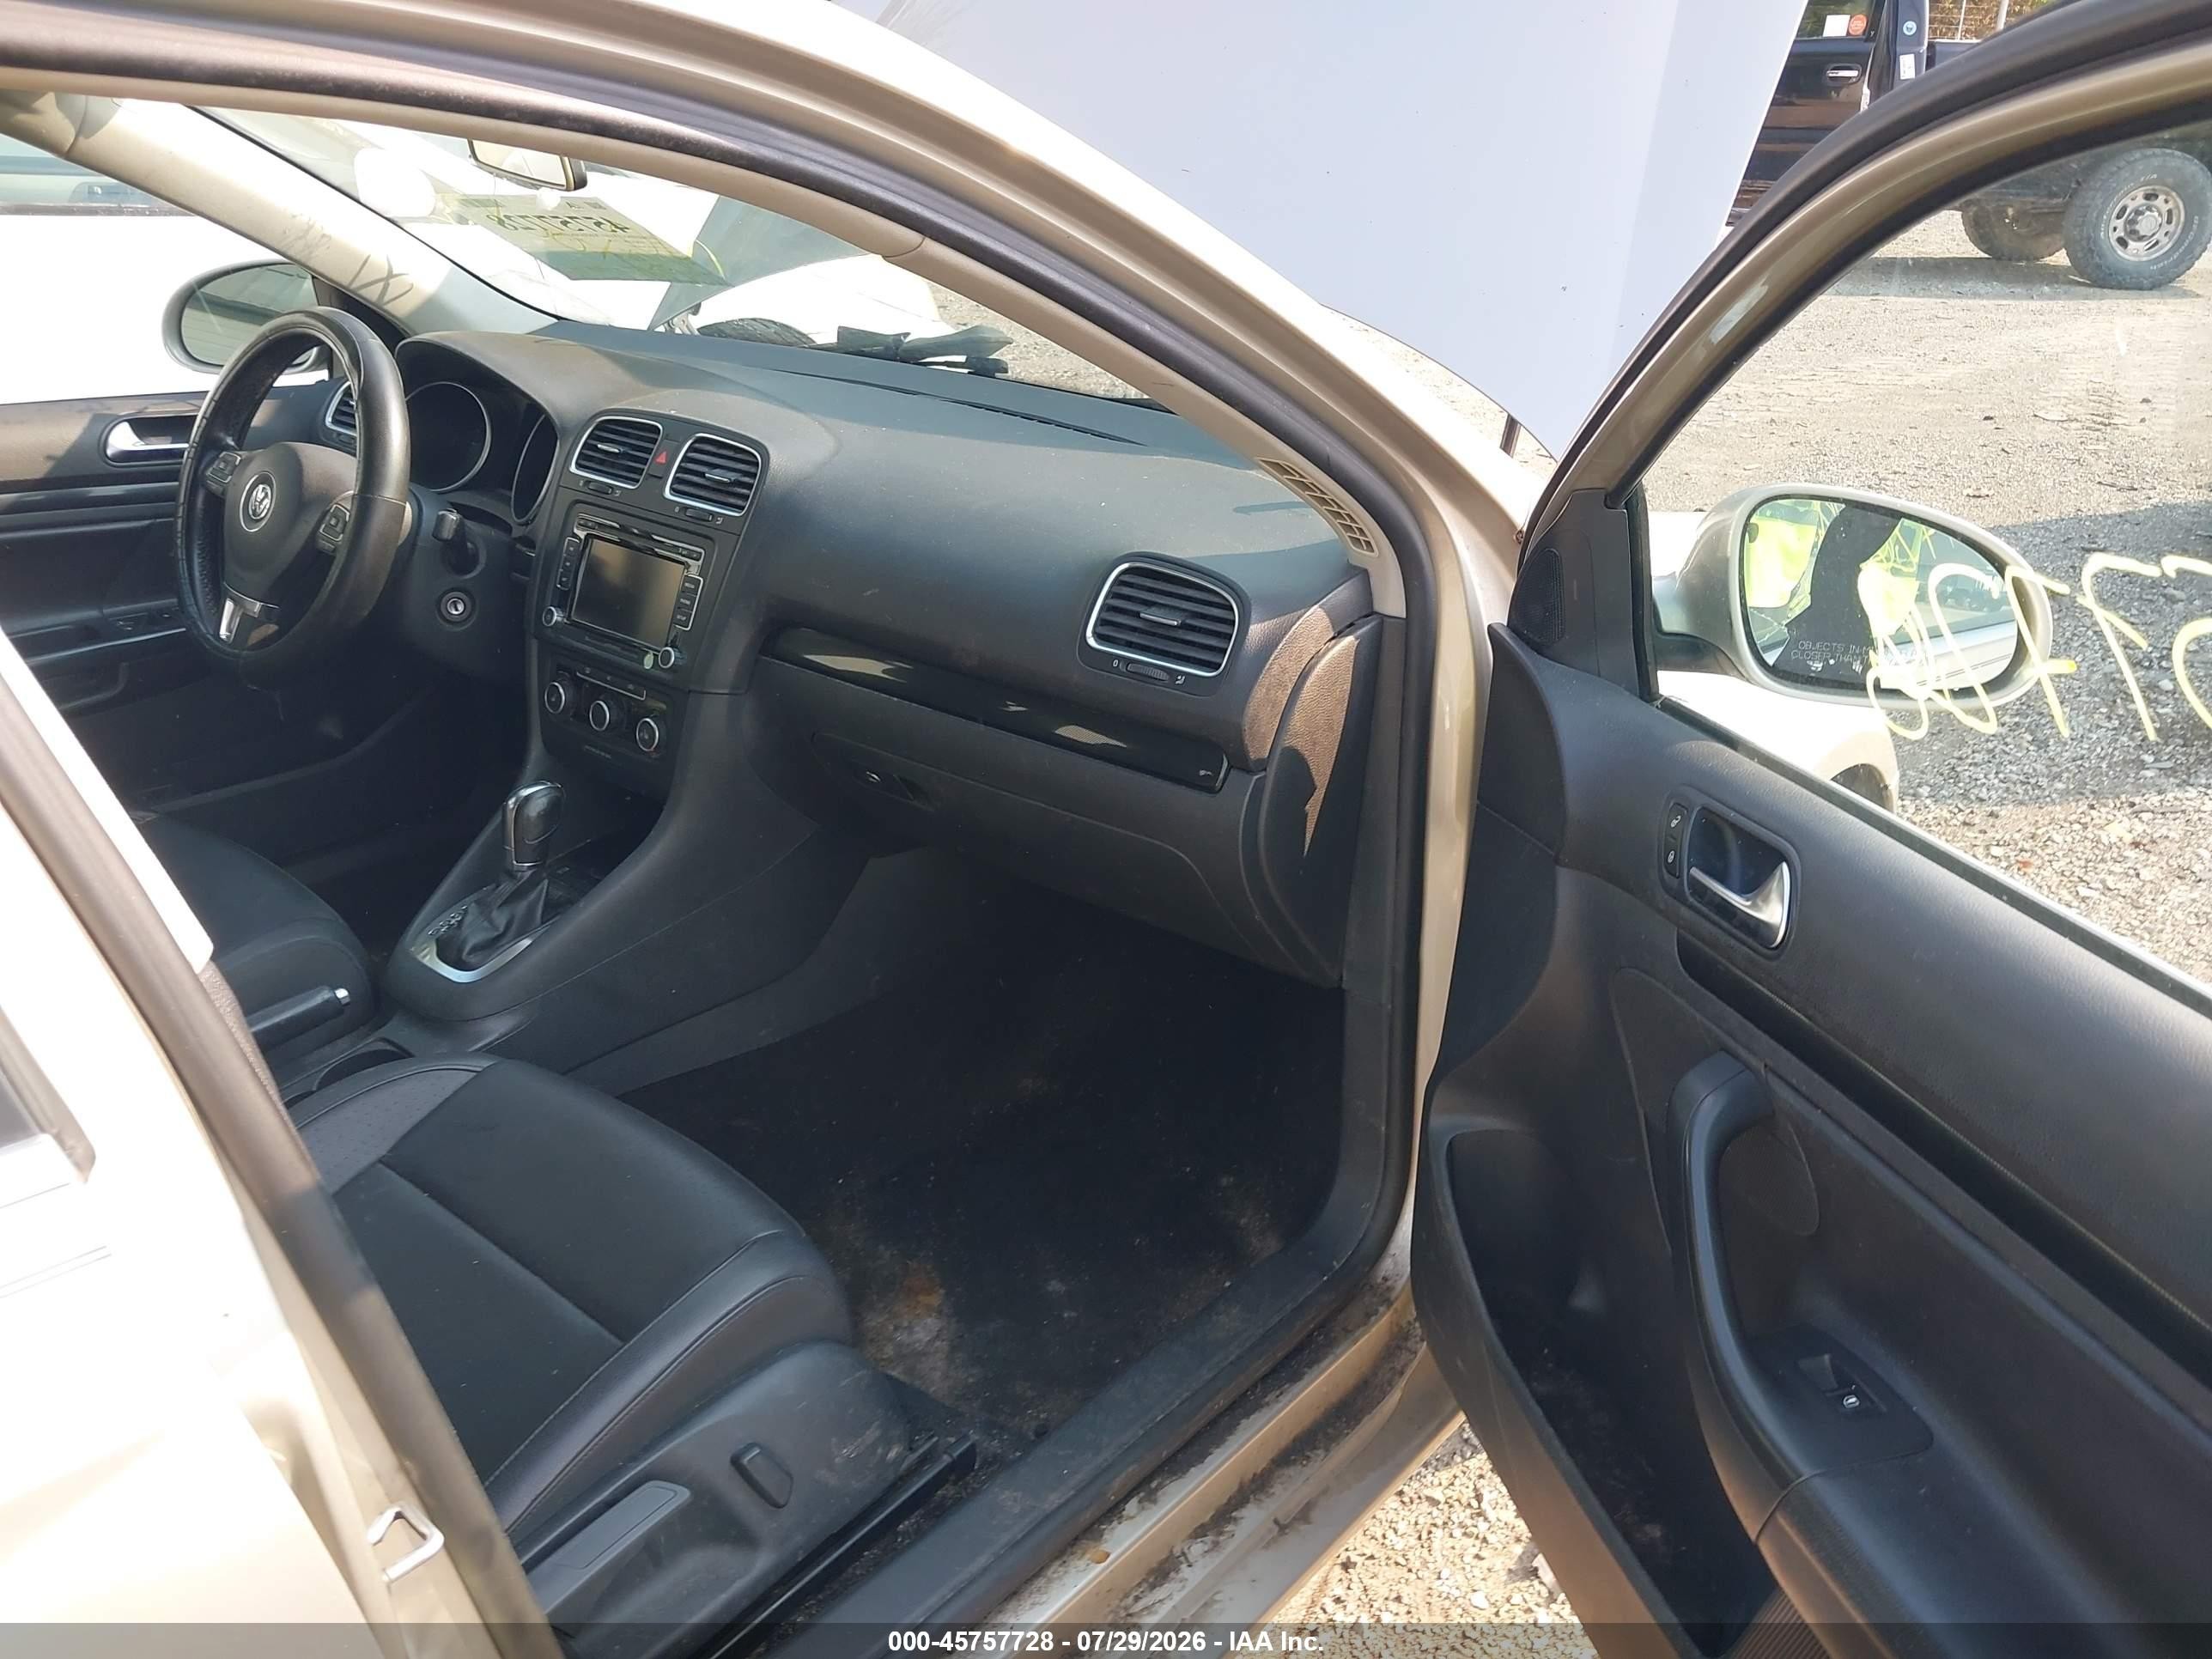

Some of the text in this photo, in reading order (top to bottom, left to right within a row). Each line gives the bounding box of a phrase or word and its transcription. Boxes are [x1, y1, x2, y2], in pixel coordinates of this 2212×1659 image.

[1798, 640, 1861, 654] OBJECTS IN
[1790, 649, 1831, 661] CLOSER
